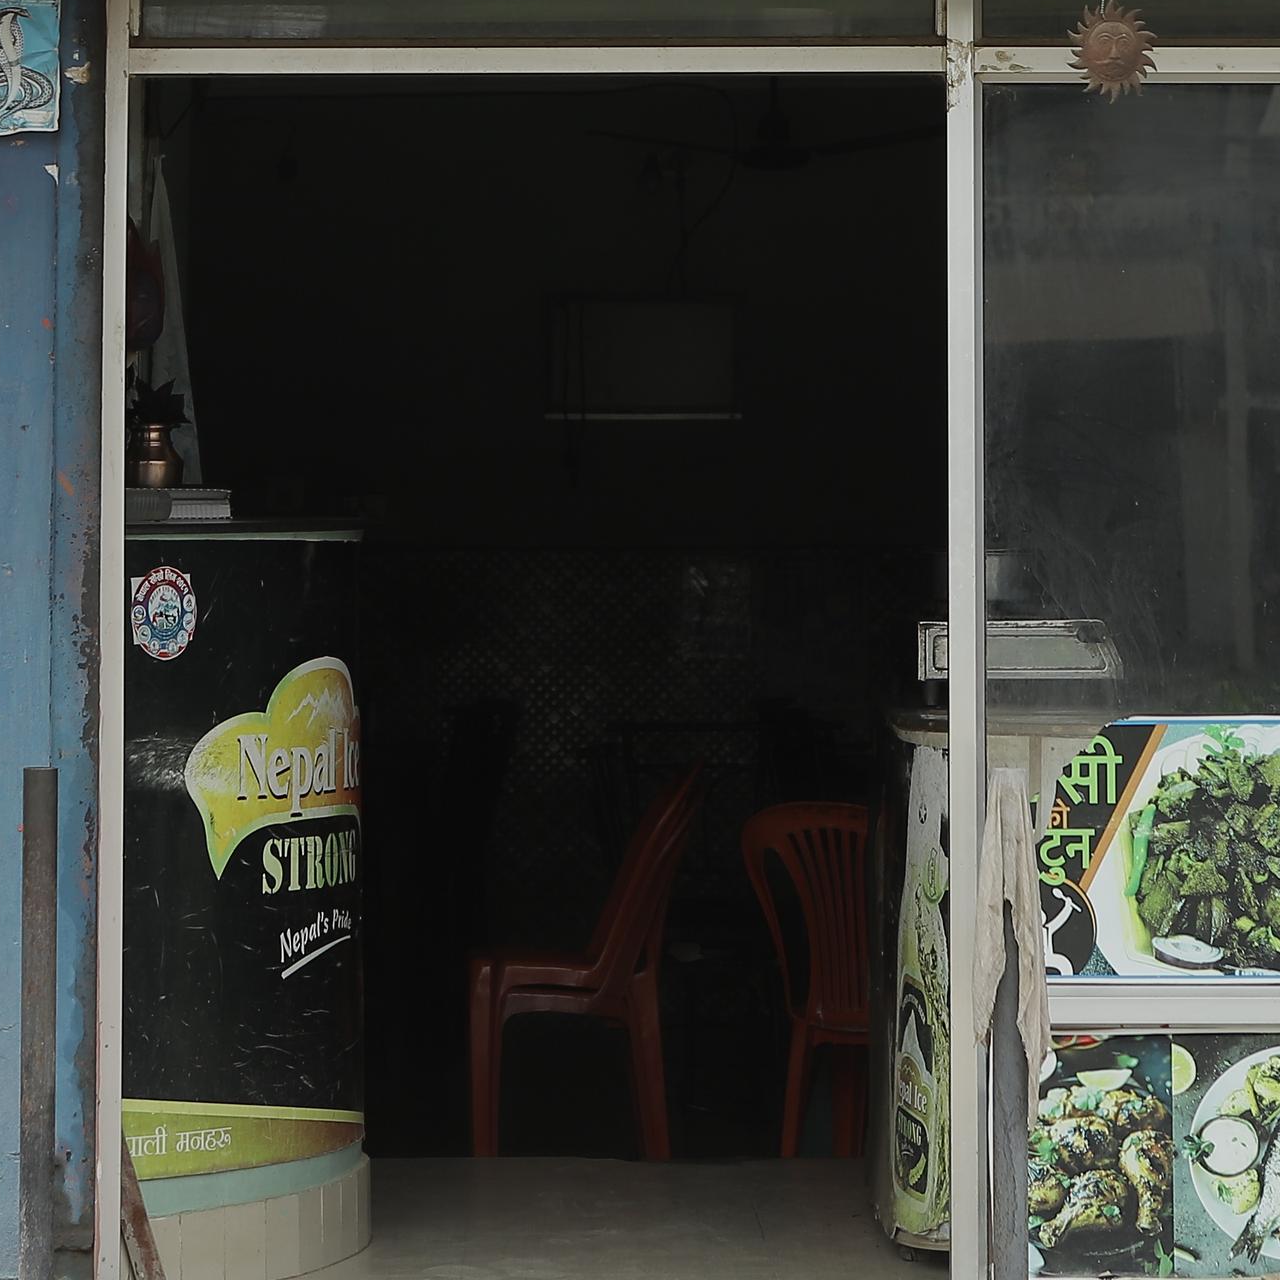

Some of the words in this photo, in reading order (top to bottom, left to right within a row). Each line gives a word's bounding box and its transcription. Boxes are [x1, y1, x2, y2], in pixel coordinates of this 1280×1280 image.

[237, 726, 337, 817] Nepal
[1046, 734, 1123, 805] सी
[262, 829, 357, 896] STRONG
[1039, 828, 1096, 886] टुन
[279, 911, 329, 964] Nepal's
